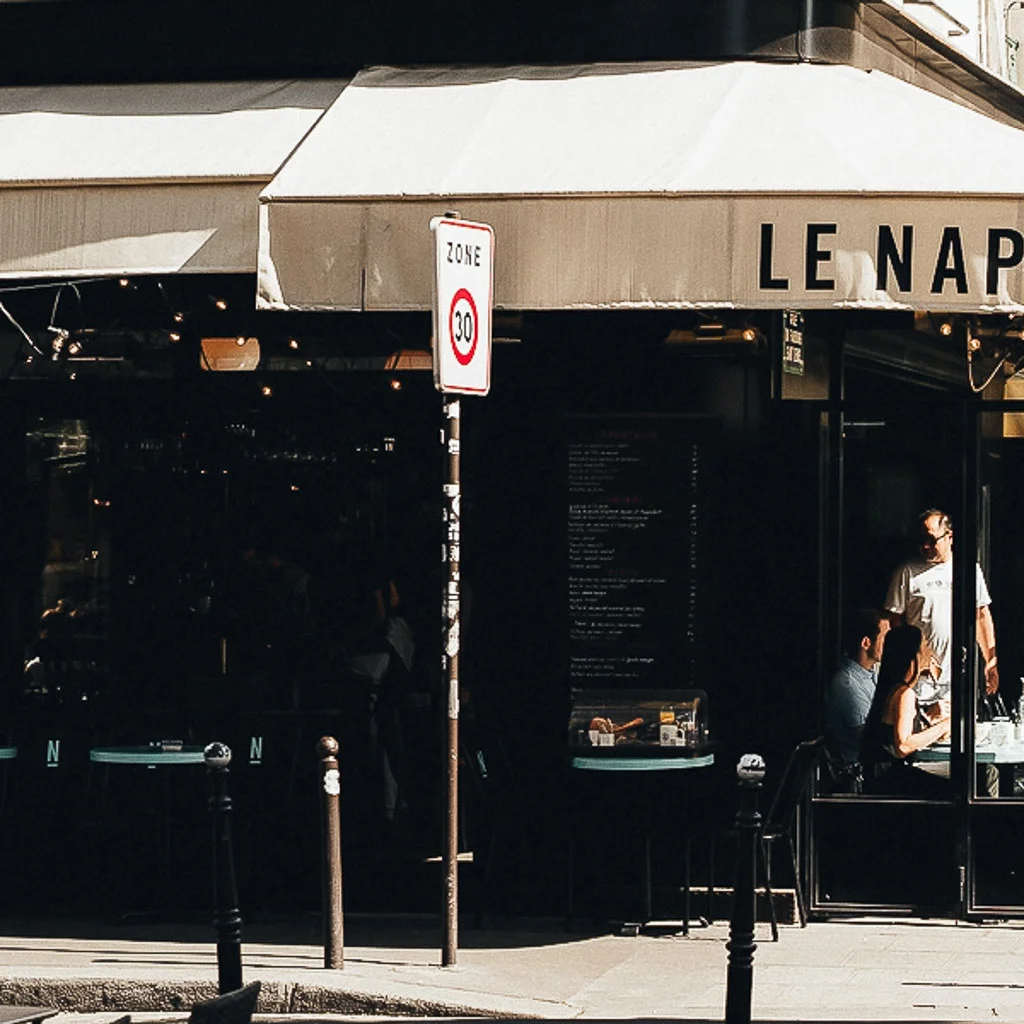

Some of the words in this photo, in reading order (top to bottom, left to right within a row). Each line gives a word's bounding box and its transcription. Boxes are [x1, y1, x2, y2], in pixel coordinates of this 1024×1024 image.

[447, 242, 481, 267] ZONE
[759, 223, 836, 290] LE
[455, 311, 472, 343] 30
